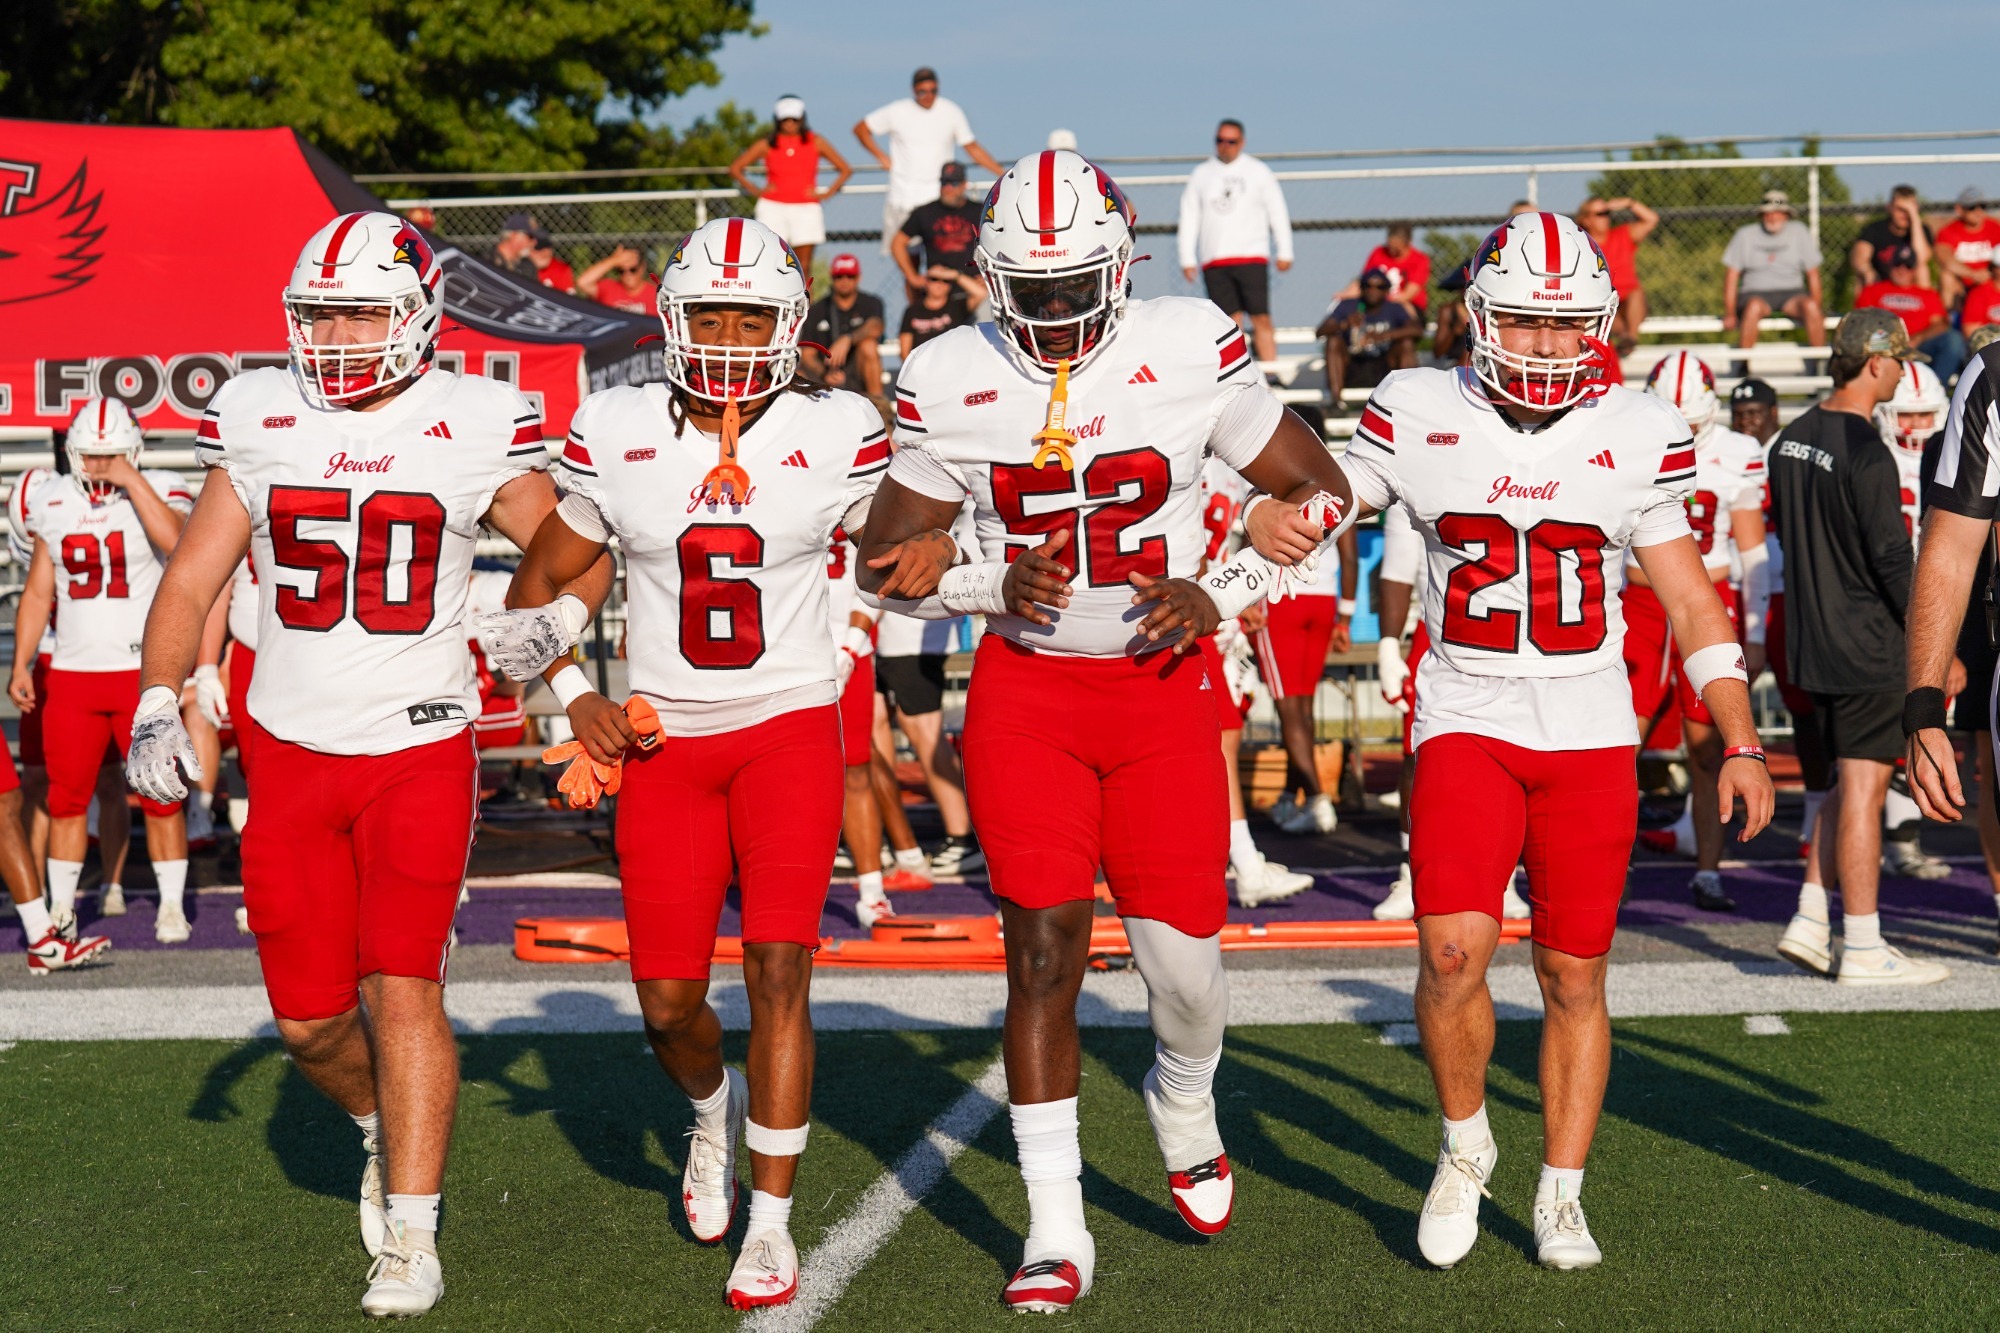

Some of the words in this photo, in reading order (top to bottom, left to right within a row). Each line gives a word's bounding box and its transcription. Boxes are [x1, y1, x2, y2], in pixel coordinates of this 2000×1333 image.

[308, 280, 343, 289] Riddell
[711, 280, 751, 289] Riddell
[1532, 291, 1573, 301] Riddell
[292, 319, 308, 350] Riddel
[964, 390, 998, 406] GLVC
[263, 415, 296, 428] GLVC
[1049, 400, 1065, 430] NXTRND
[1427, 432, 1459, 446] GLVC
[324, 452, 395, 479] Jewell
[624, 448, 656, 462] GLVC
[1487, 475, 1561, 504] Jewell
[989, 446, 1173, 590] 52
[61, 530, 129, 600] 91
[268, 484, 447, 635] 50
[962, 572, 985, 584] 4:13
[1434, 511, 1607, 656] 20
[676, 522, 766, 670] 6
[434, 709, 444, 717] XL
